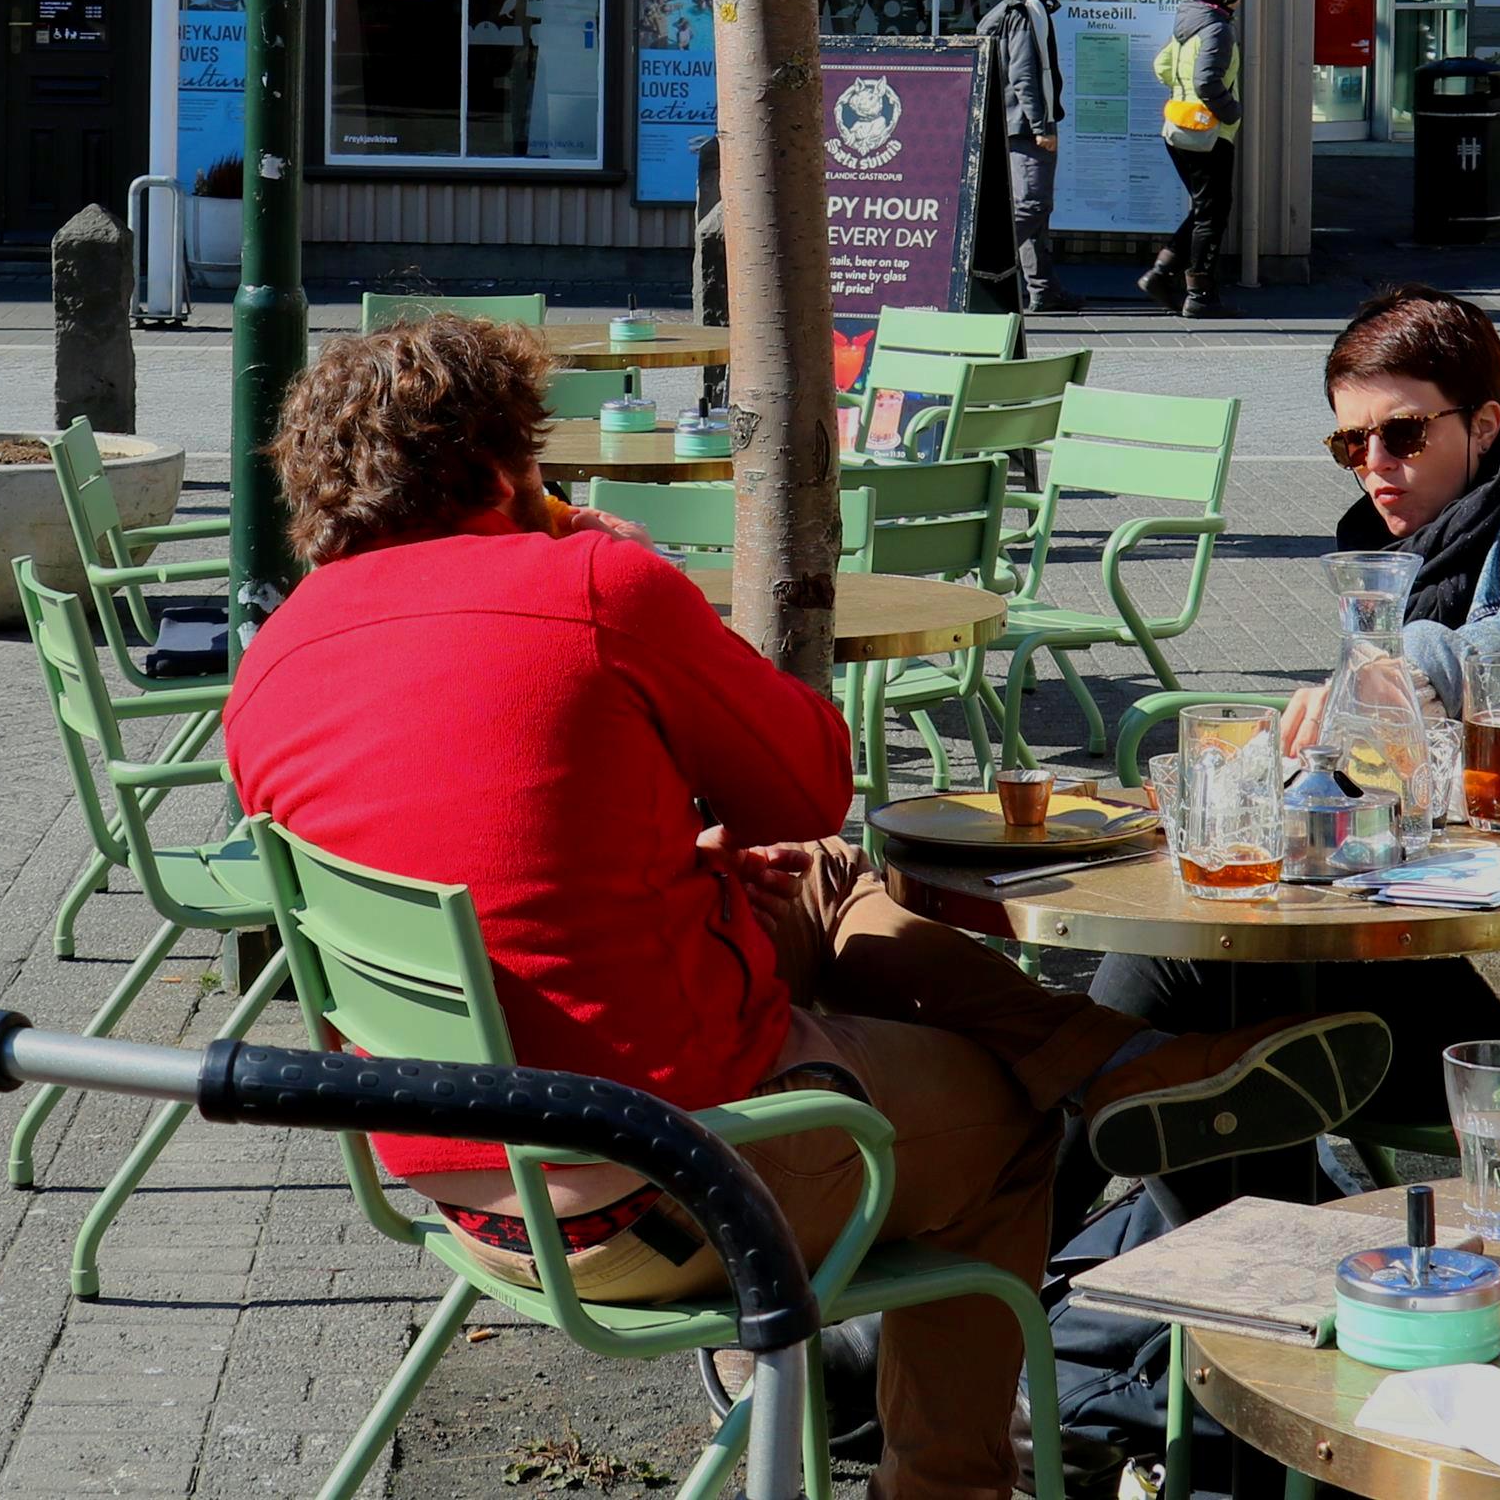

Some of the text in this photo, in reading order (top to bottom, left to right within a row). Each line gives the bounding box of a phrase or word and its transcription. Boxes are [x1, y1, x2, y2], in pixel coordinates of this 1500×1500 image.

[1067, 6, 1137, 20] Matseðill.
[1158, 3, 1179, 12] Bist
[1087, 21, 1117, 30] Menu.
[179, 46, 220, 63] OVES
[641, 81, 689, 99] LOVES
[640, 100, 718, 120] activit
[825, 171, 903, 182] ELANDIC GASTROPUB
[827, 196, 939, 222] PY HOUR
[828, 226, 939, 248] EVERY DAY
[855, 256, 877, 267] beer
[878, 259, 892, 268] on
[893, 258, 910, 270] tap
[845, 269, 868, 280] wine
[869, 269, 882, 282] by
[883, 270, 907, 283] glass
[831, 282, 875, 295] alf price!
